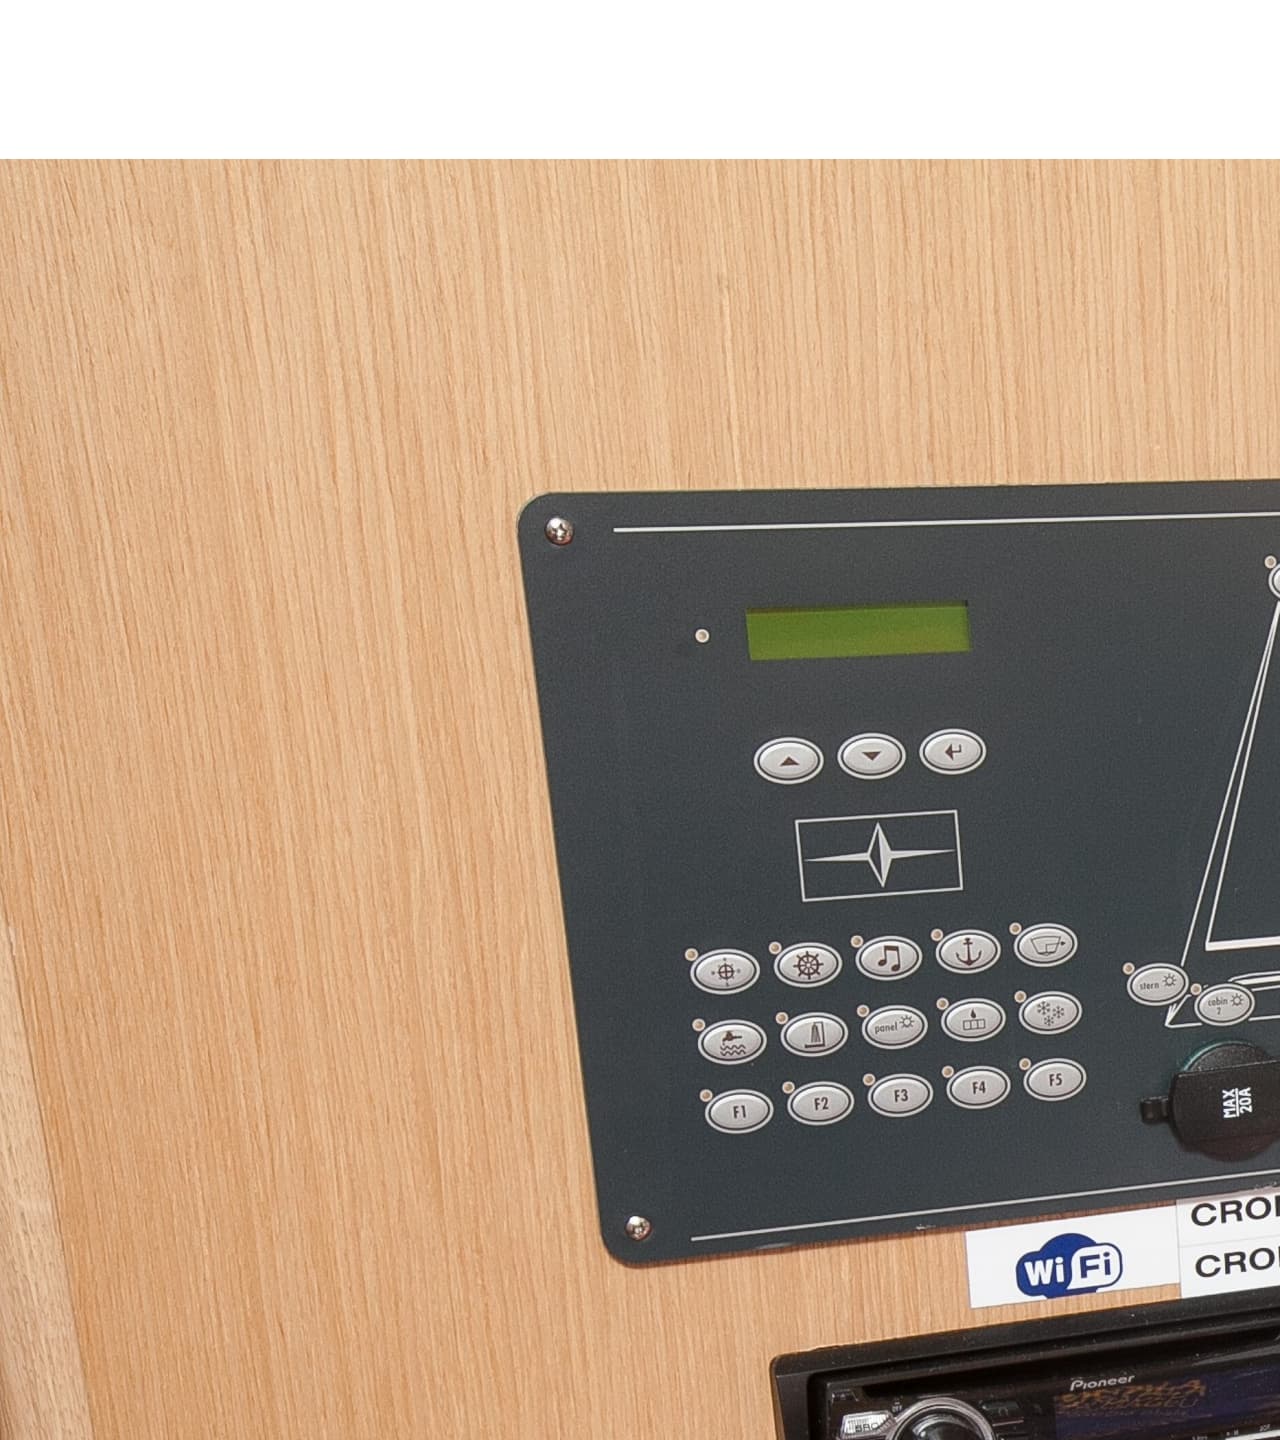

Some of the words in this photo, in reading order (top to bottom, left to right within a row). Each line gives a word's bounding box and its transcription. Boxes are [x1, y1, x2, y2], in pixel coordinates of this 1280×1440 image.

[1140, 981, 1159, 990] stern
[1208, 997, 1228, 1007] cabin
[875, 1022, 898, 1033] panel
[1049, 1073, 1063, 1086] F5
[972, 1081, 986, 1094] F4
[894, 1089, 908, 1102] F3
[1240, 1087, 1252, 1113] 20A
[815, 1097, 829, 1110] F2
[1222, 1088, 1237, 1119] MAX
[733, 1105, 746, 1118] F1
[1070, 1375, 1135, 1391] Pioneer
